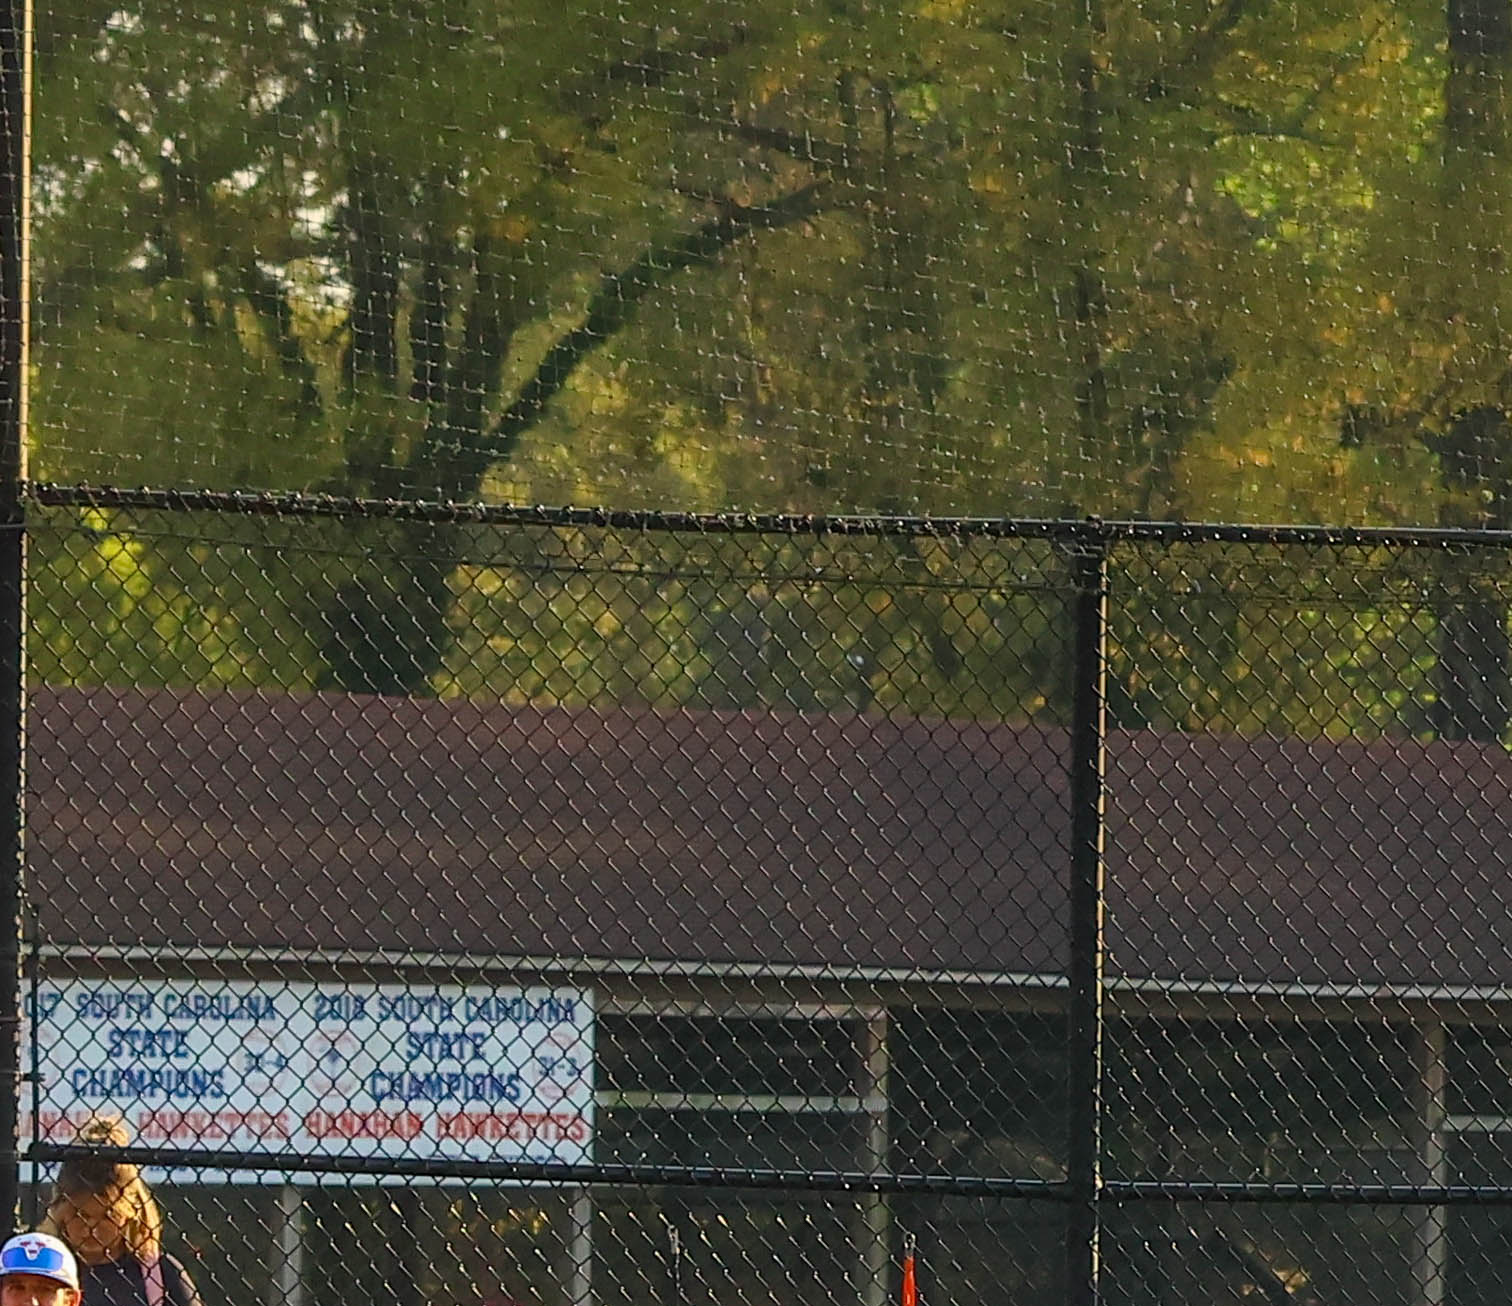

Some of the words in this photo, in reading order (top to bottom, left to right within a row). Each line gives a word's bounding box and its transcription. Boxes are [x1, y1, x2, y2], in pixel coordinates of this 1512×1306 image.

[76, 993, 153, 1020] SOUTH
[164, 994, 276, 1021] CAROLINA
[314, 995, 365, 1021] 2018
[378, 996, 454, 1022] SOUTH
[464, 997, 576, 1023] CAROLINA
[108, 1029, 189, 1058] STATE
[406, 1031, 487, 1060] STATE
[72, 1069, 225, 1099] CHAMPIONS
[370, 1071, 521, 1101] CHAMPIONS
[139, 1111, 289, 1140] HAWKETTES
[305, 1111, 423, 1139] HANAHAN
[436, 1112, 586, 1141] HAWKETTES
